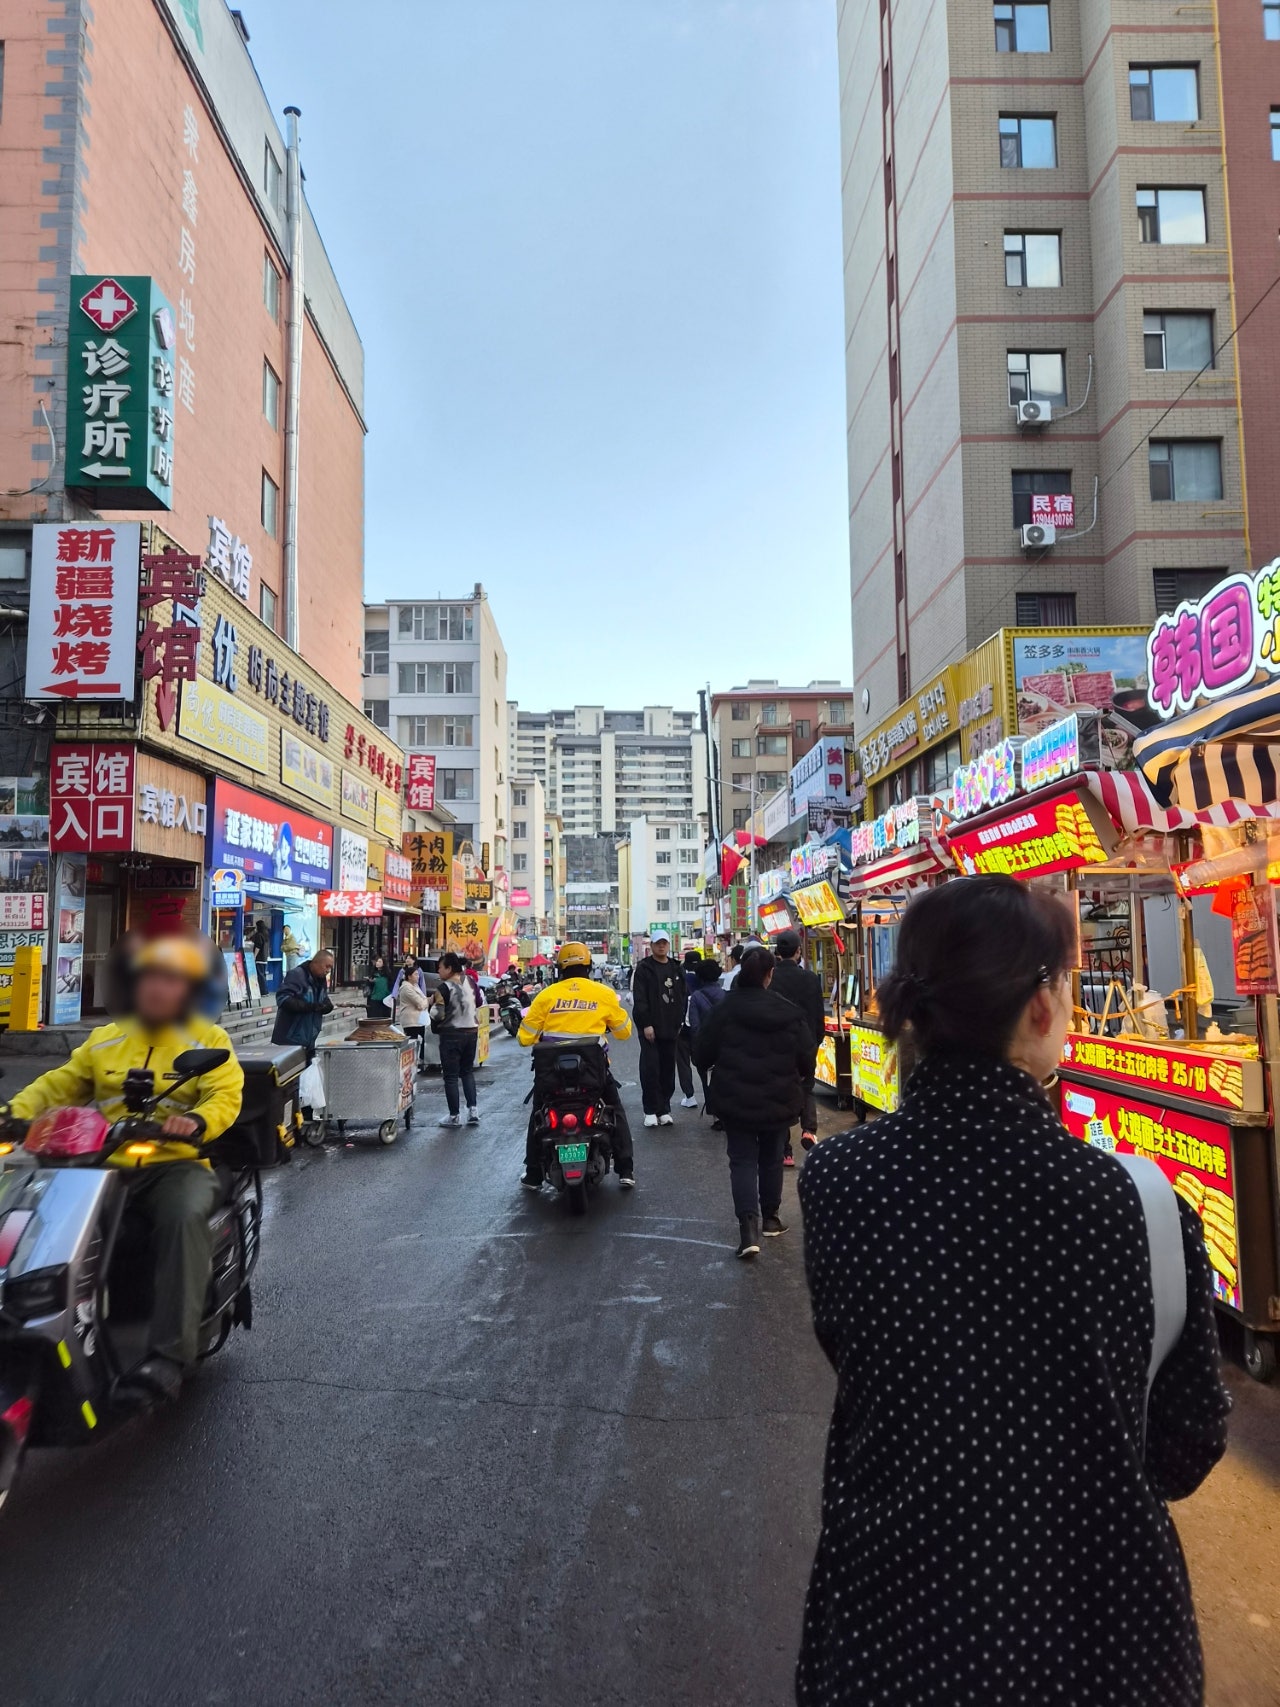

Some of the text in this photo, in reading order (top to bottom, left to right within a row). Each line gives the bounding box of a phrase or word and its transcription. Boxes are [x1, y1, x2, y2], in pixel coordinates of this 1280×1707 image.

[81, 338, 132, 459] 诊疗所
[1033, 494, 1073, 512] 民宿
[208, 516, 252, 600] 宾馆
[51, 528, 116, 675] 新疆烧烤
[137, 545, 201, 682] 宾馆
[1024, 644, 1065, 659] 签多多
[1152, 582, 1254, 708] 韩国
[56, 752, 129, 795] 宾馆
[410, 757, 434, 808] 宾馆
[54, 802, 124, 841] 入口
[139, 784, 207, 837] 宾馆入口
[410, 835, 446, 857] 牛肉
[323, 892, 380, 915] 梅菜
[449, 918, 479, 938] 炸鸡
[1075, 1041, 1207, 1092] 火鸡面芝士五花肉卷 25/份
[1117, 1106, 1227, 1179] 火鸡面芝士五花肉卷
